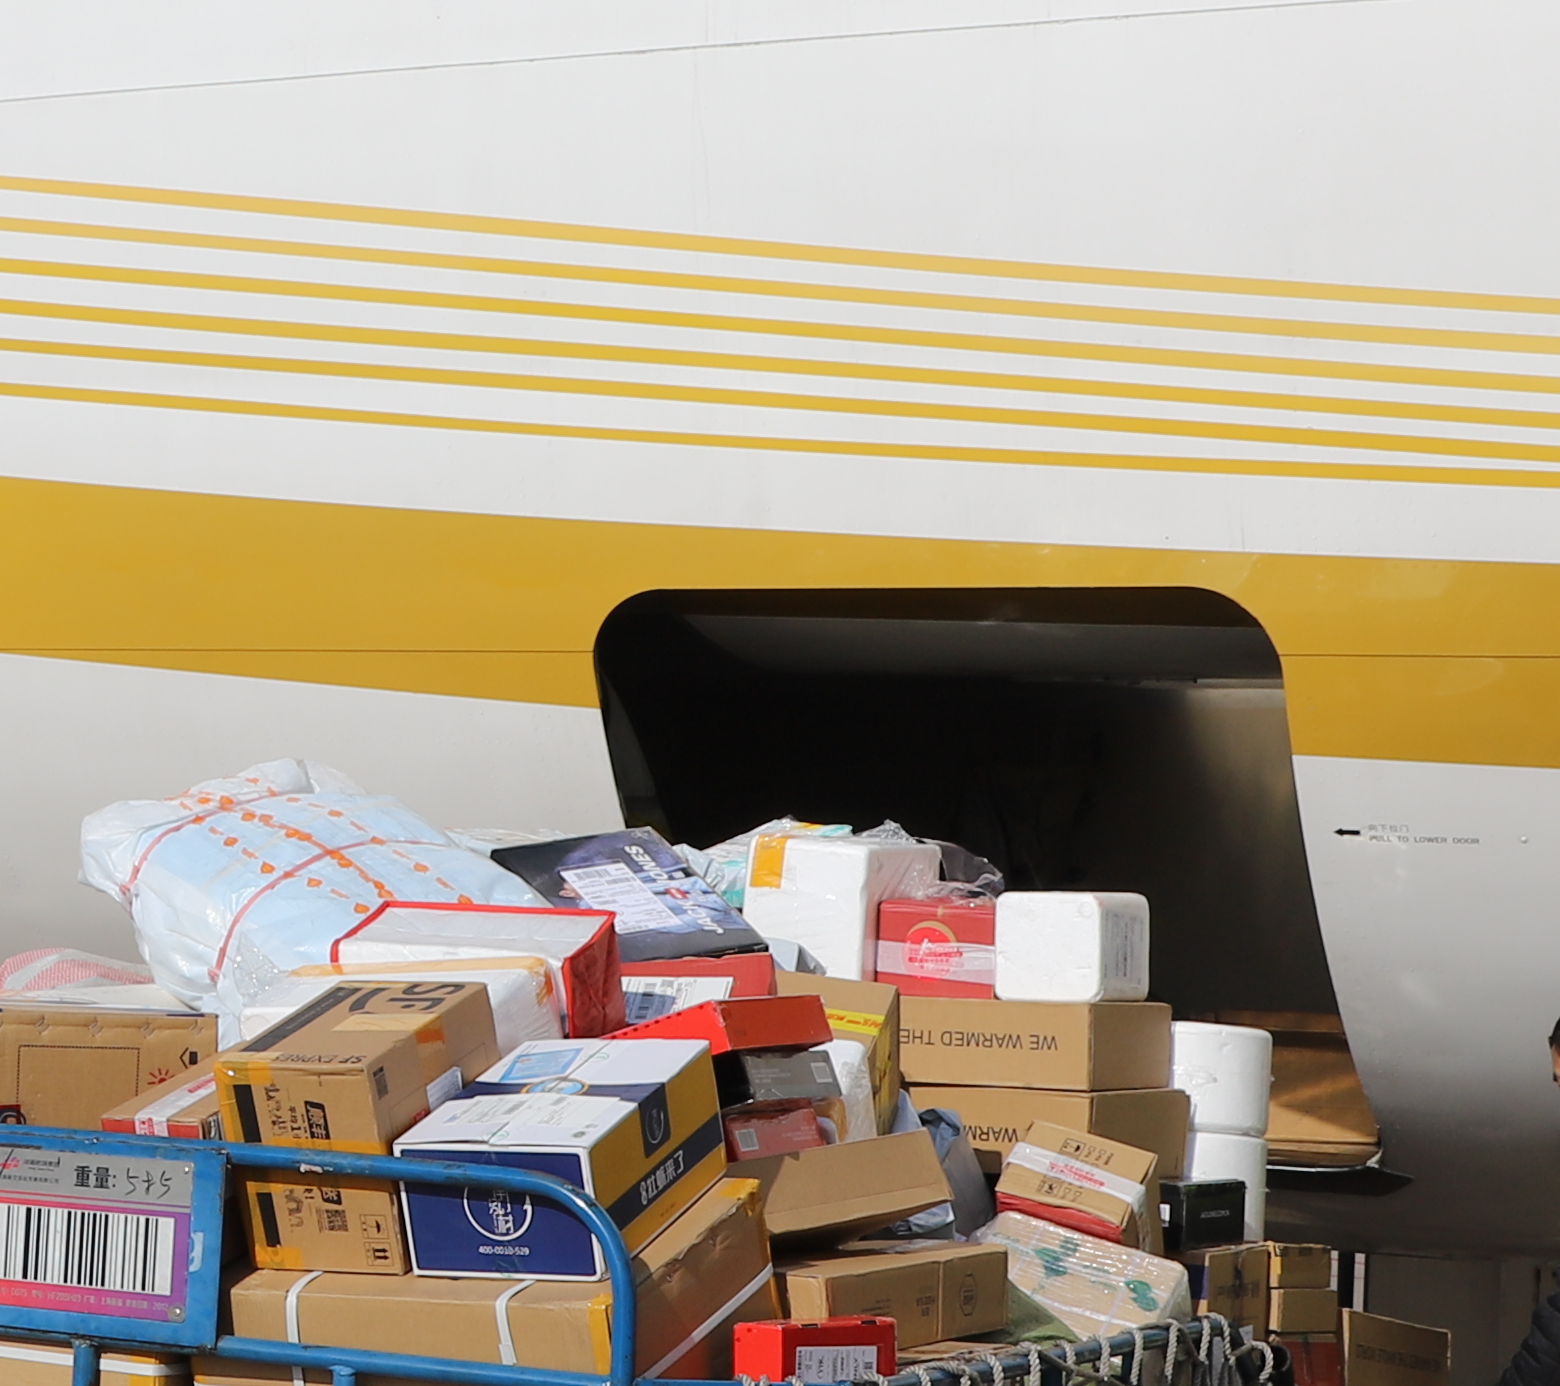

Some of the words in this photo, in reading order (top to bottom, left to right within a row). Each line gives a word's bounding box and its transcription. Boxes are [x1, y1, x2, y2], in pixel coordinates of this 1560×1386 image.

[1369, 835, 1393, 843] PULL
[1414, 836, 1448, 844] LOWER
[899, 1027, 936, 1046] THE
[940, 1030, 1023, 1050] WARMED
[1030, 1033, 1058, 1051] WE
[963, 1124, 1019, 1144] WARM
